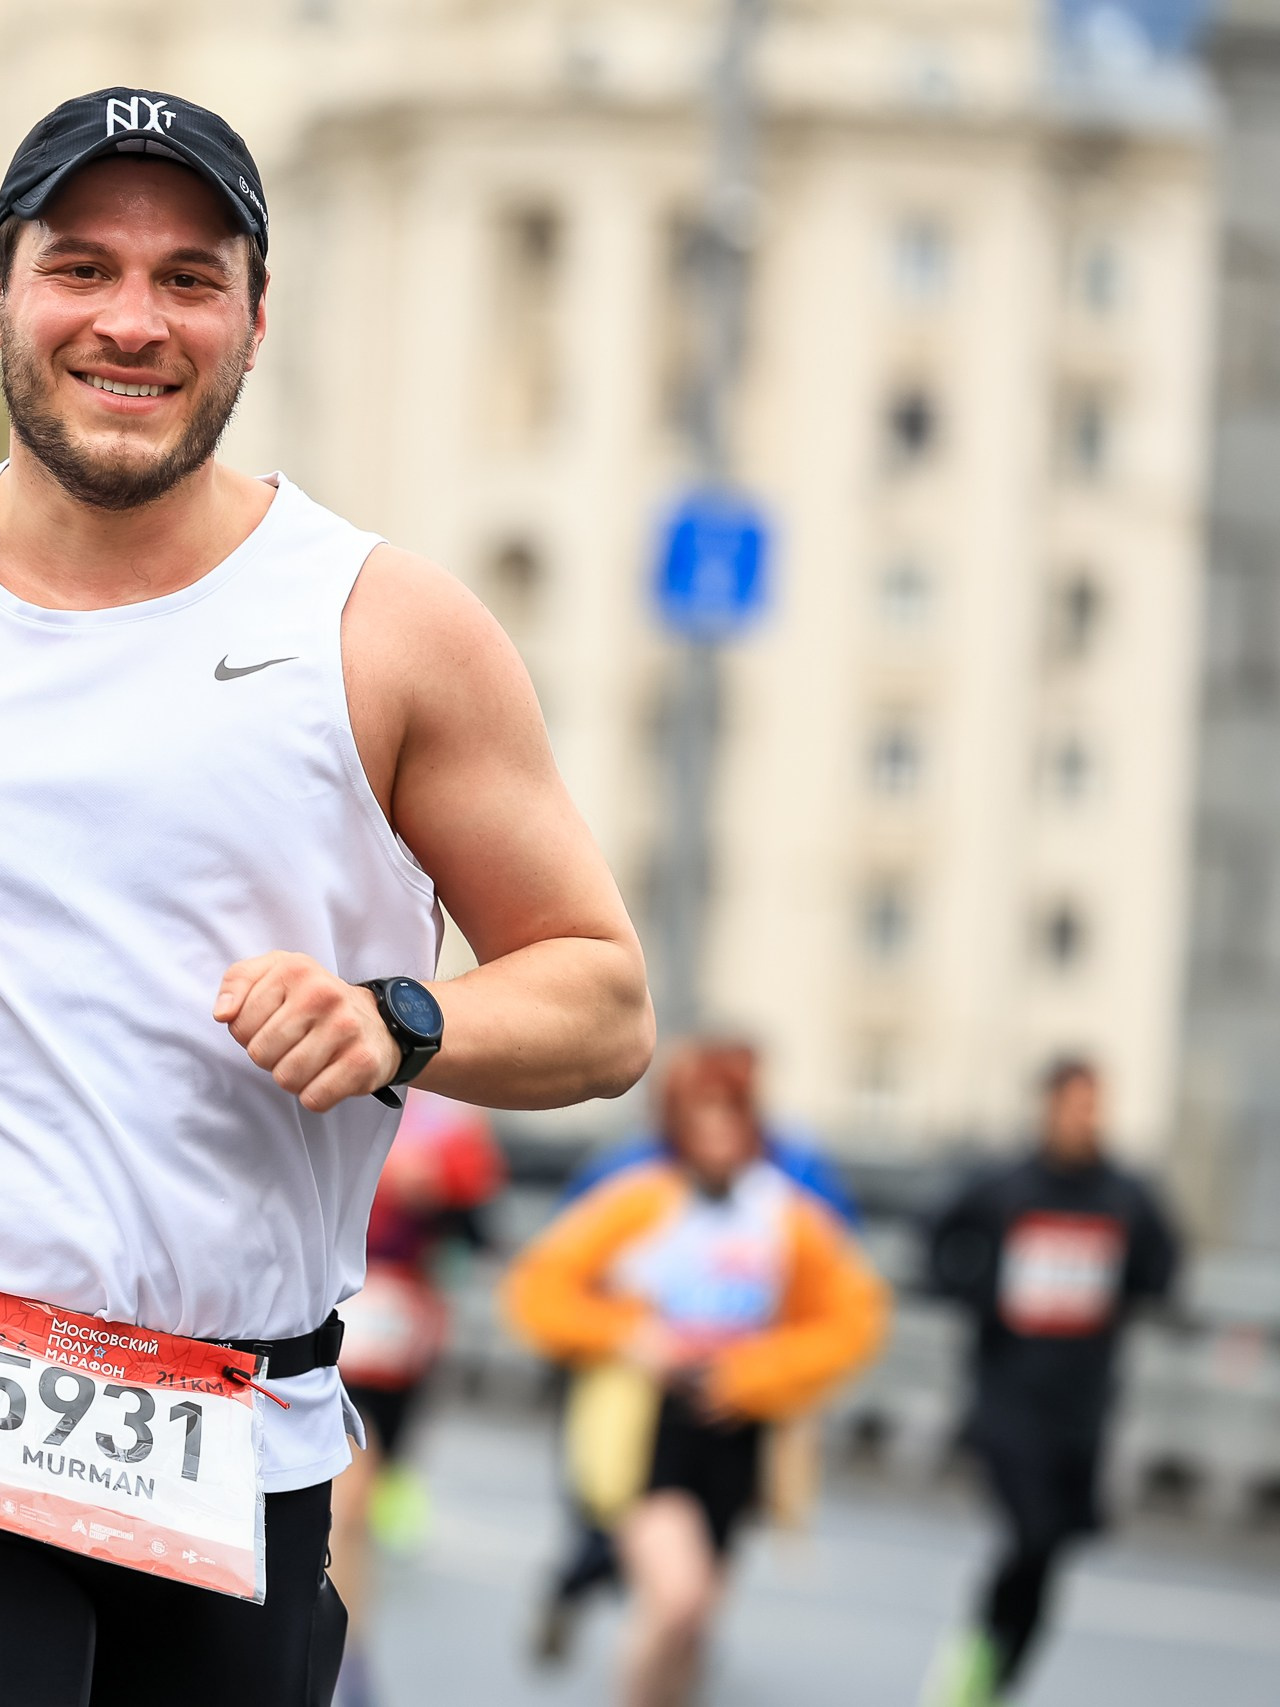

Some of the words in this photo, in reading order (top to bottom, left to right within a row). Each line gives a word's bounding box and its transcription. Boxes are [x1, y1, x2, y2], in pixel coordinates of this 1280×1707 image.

[47, 1334, 94, 1354] ПОЛУ
[51, 1317, 159, 1355] МОСКОВСКИЙ
[45, 1347, 125, 1379] МАРАФОН
[22, 1445, 155, 1500] MURMAN
